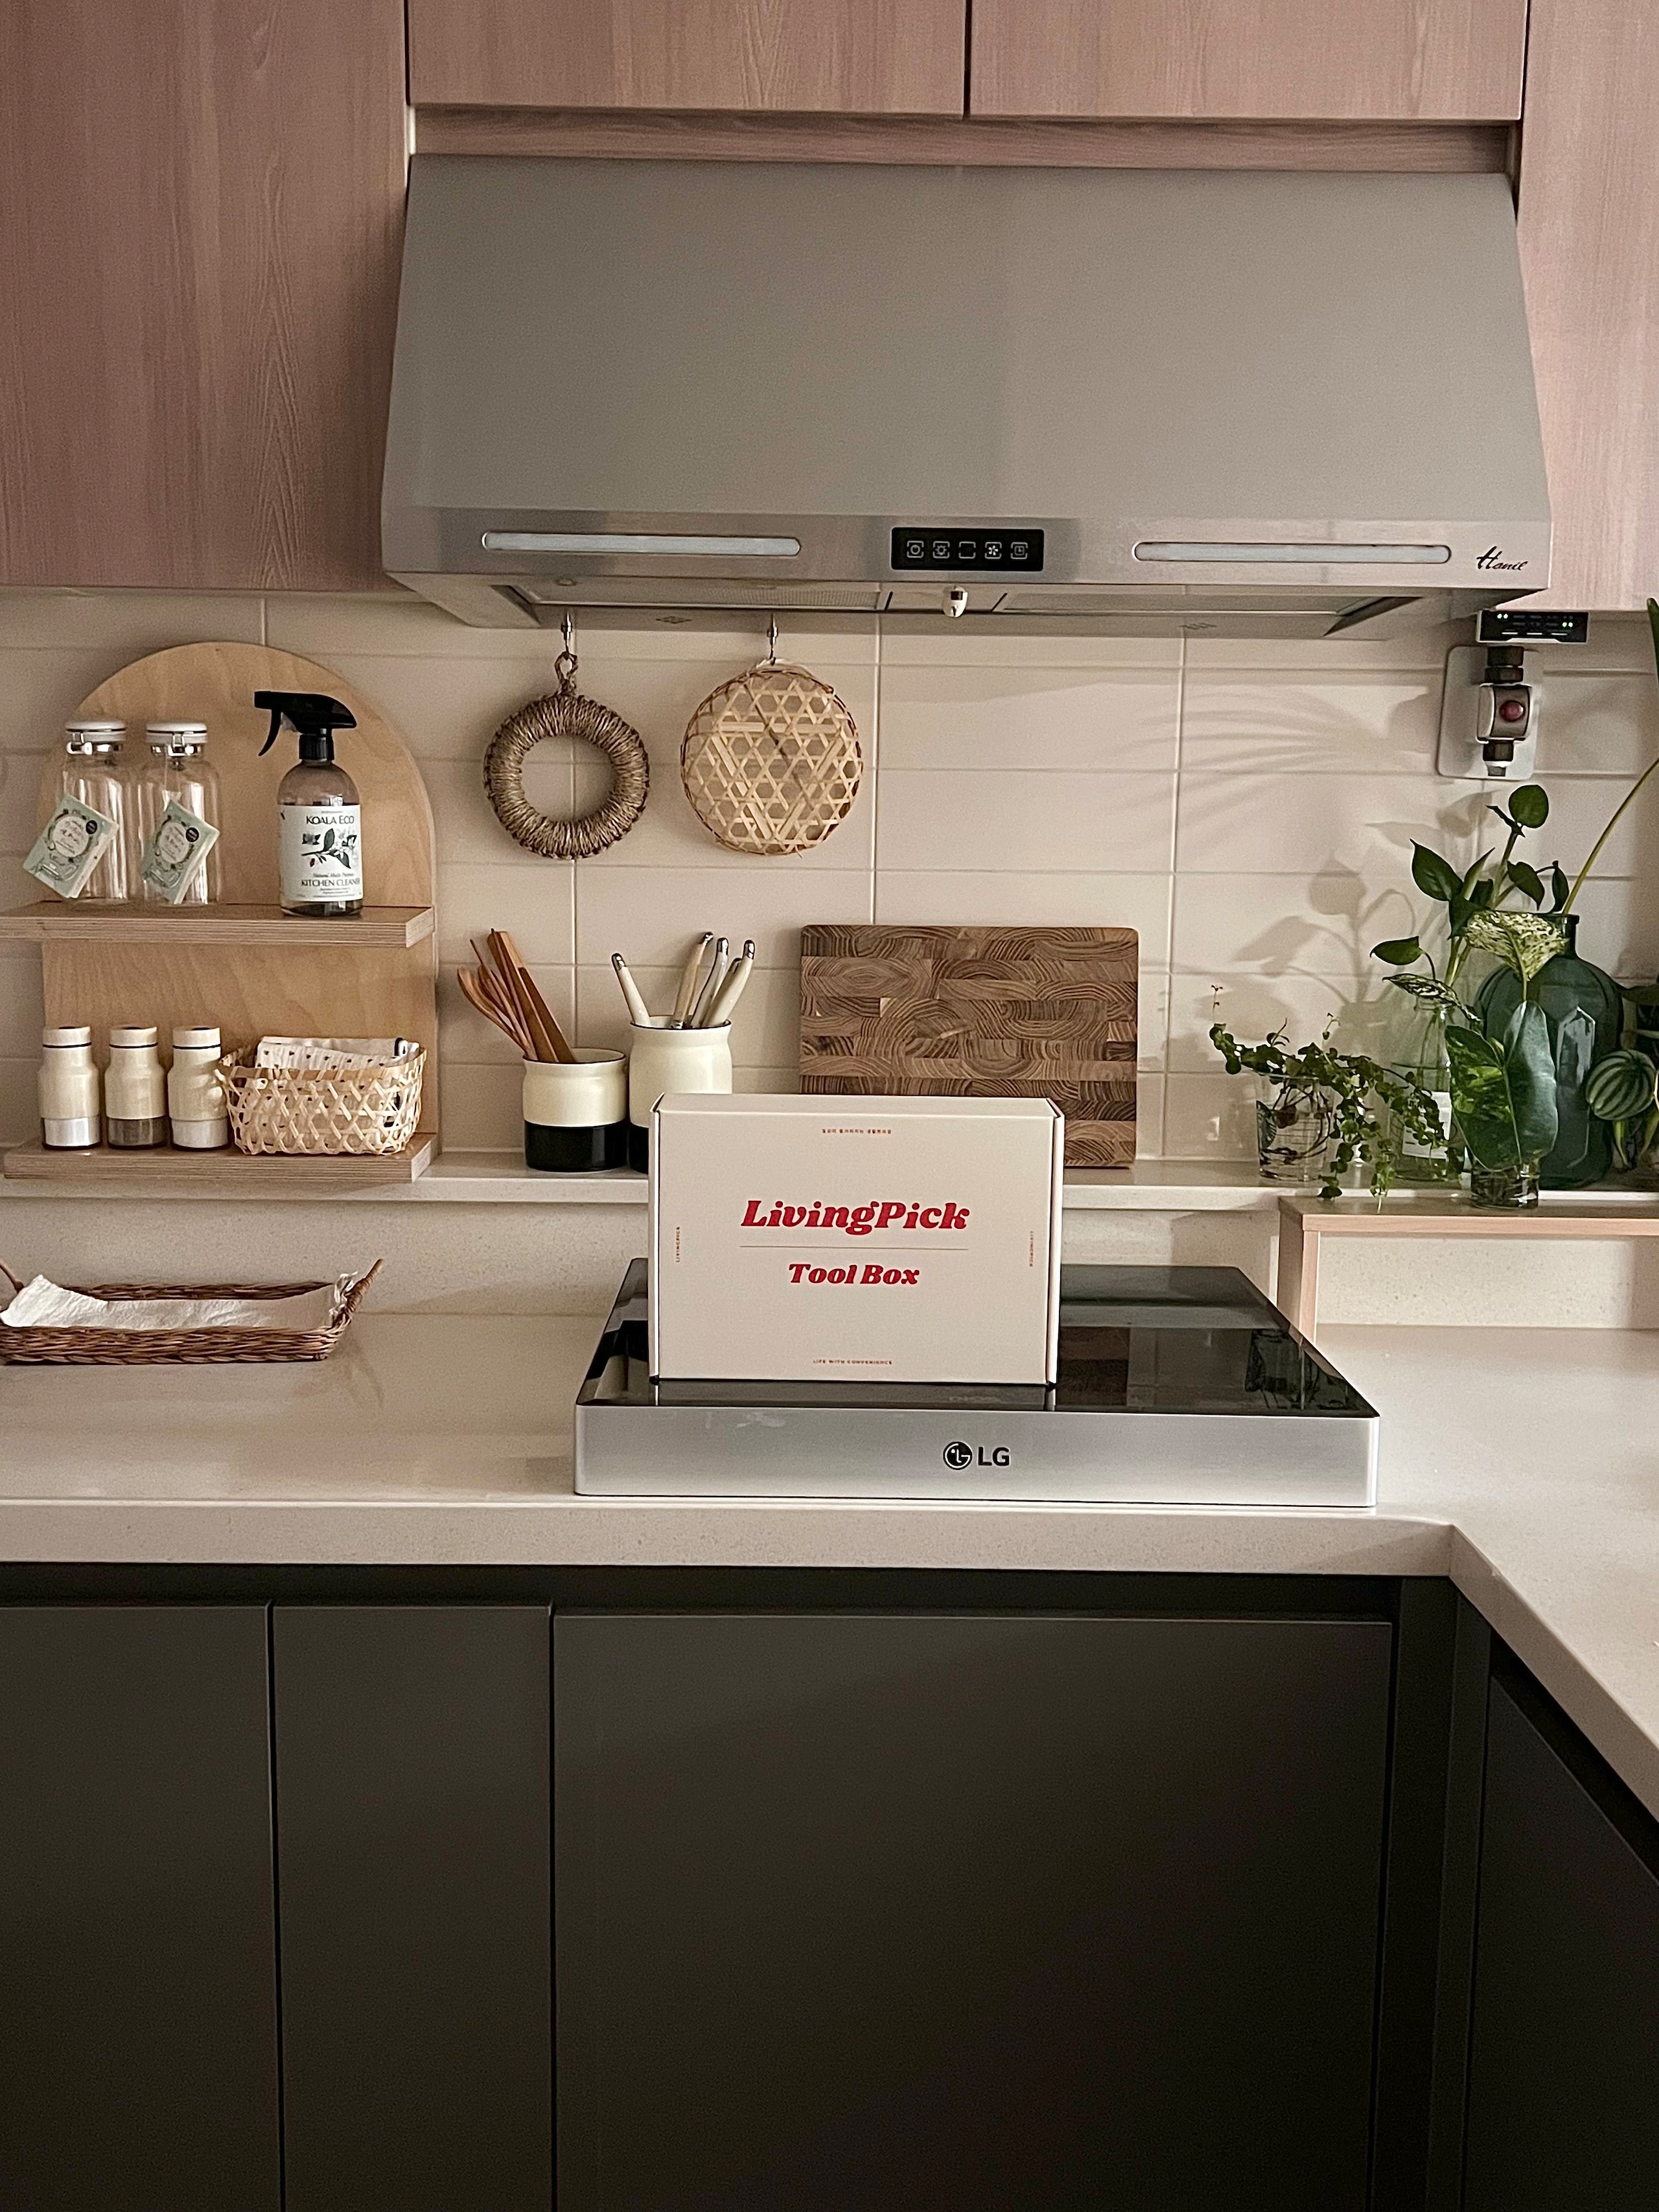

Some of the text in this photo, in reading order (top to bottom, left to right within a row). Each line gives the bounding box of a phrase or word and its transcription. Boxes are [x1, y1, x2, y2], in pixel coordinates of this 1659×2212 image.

[306, 815, 354, 824] KOALA ECO
[741, 1200, 970, 1235] LivingPick
[789, 1264, 920, 1285] Tool Box
[978, 1446, 1010, 1466] LG
